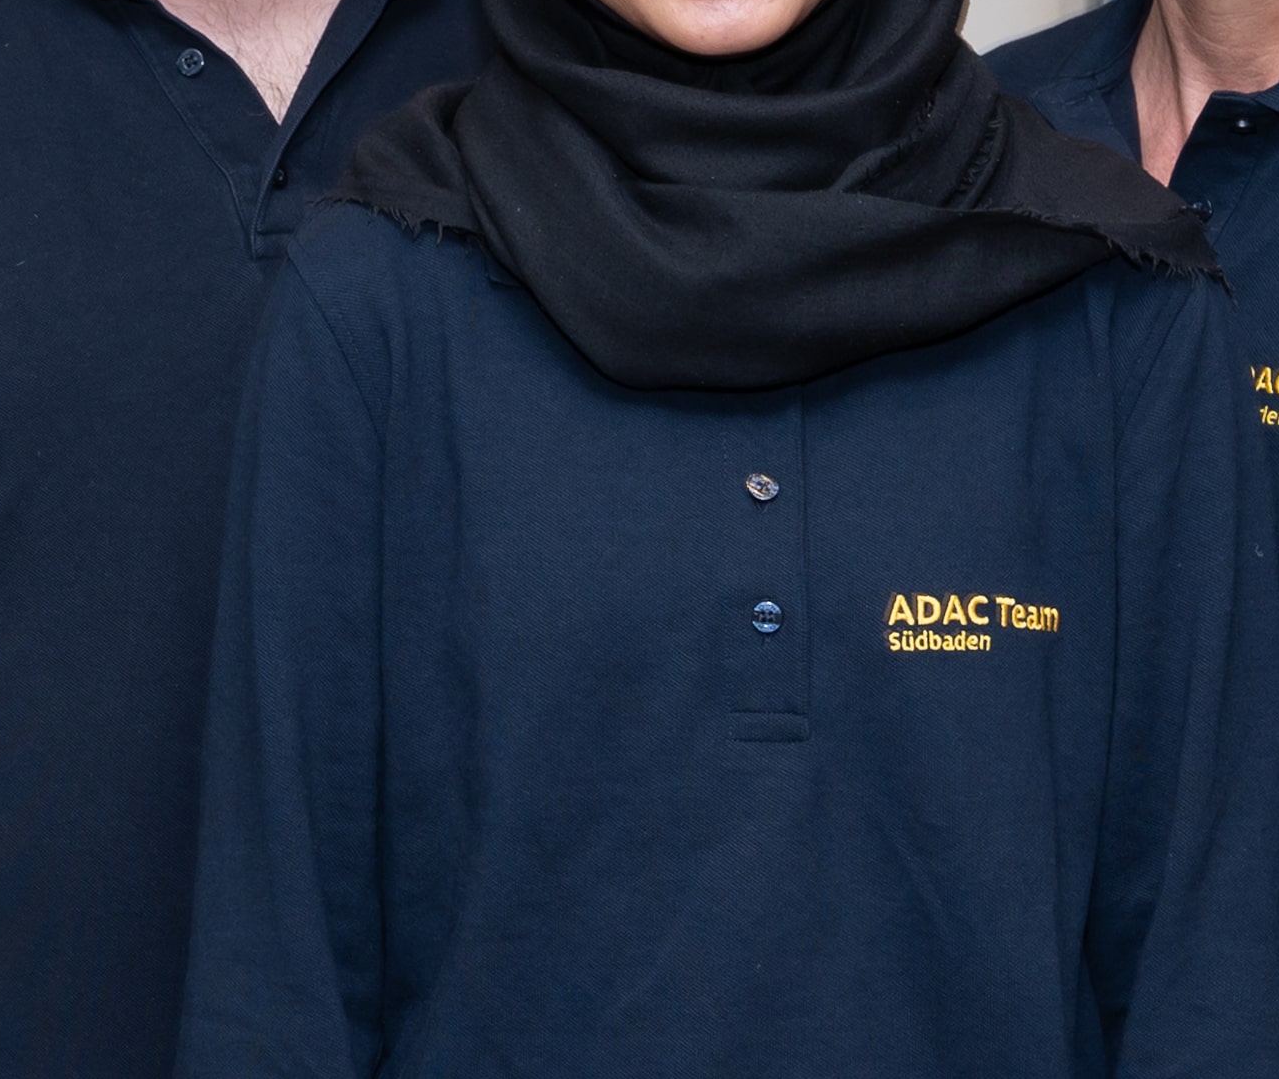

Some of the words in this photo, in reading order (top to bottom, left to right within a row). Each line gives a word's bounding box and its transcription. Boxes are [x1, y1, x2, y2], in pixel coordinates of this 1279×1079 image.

[888, 594, 990, 626] ADAC
[995, 596, 1060, 632] Team
[888, 630, 992, 652] Südbaden
